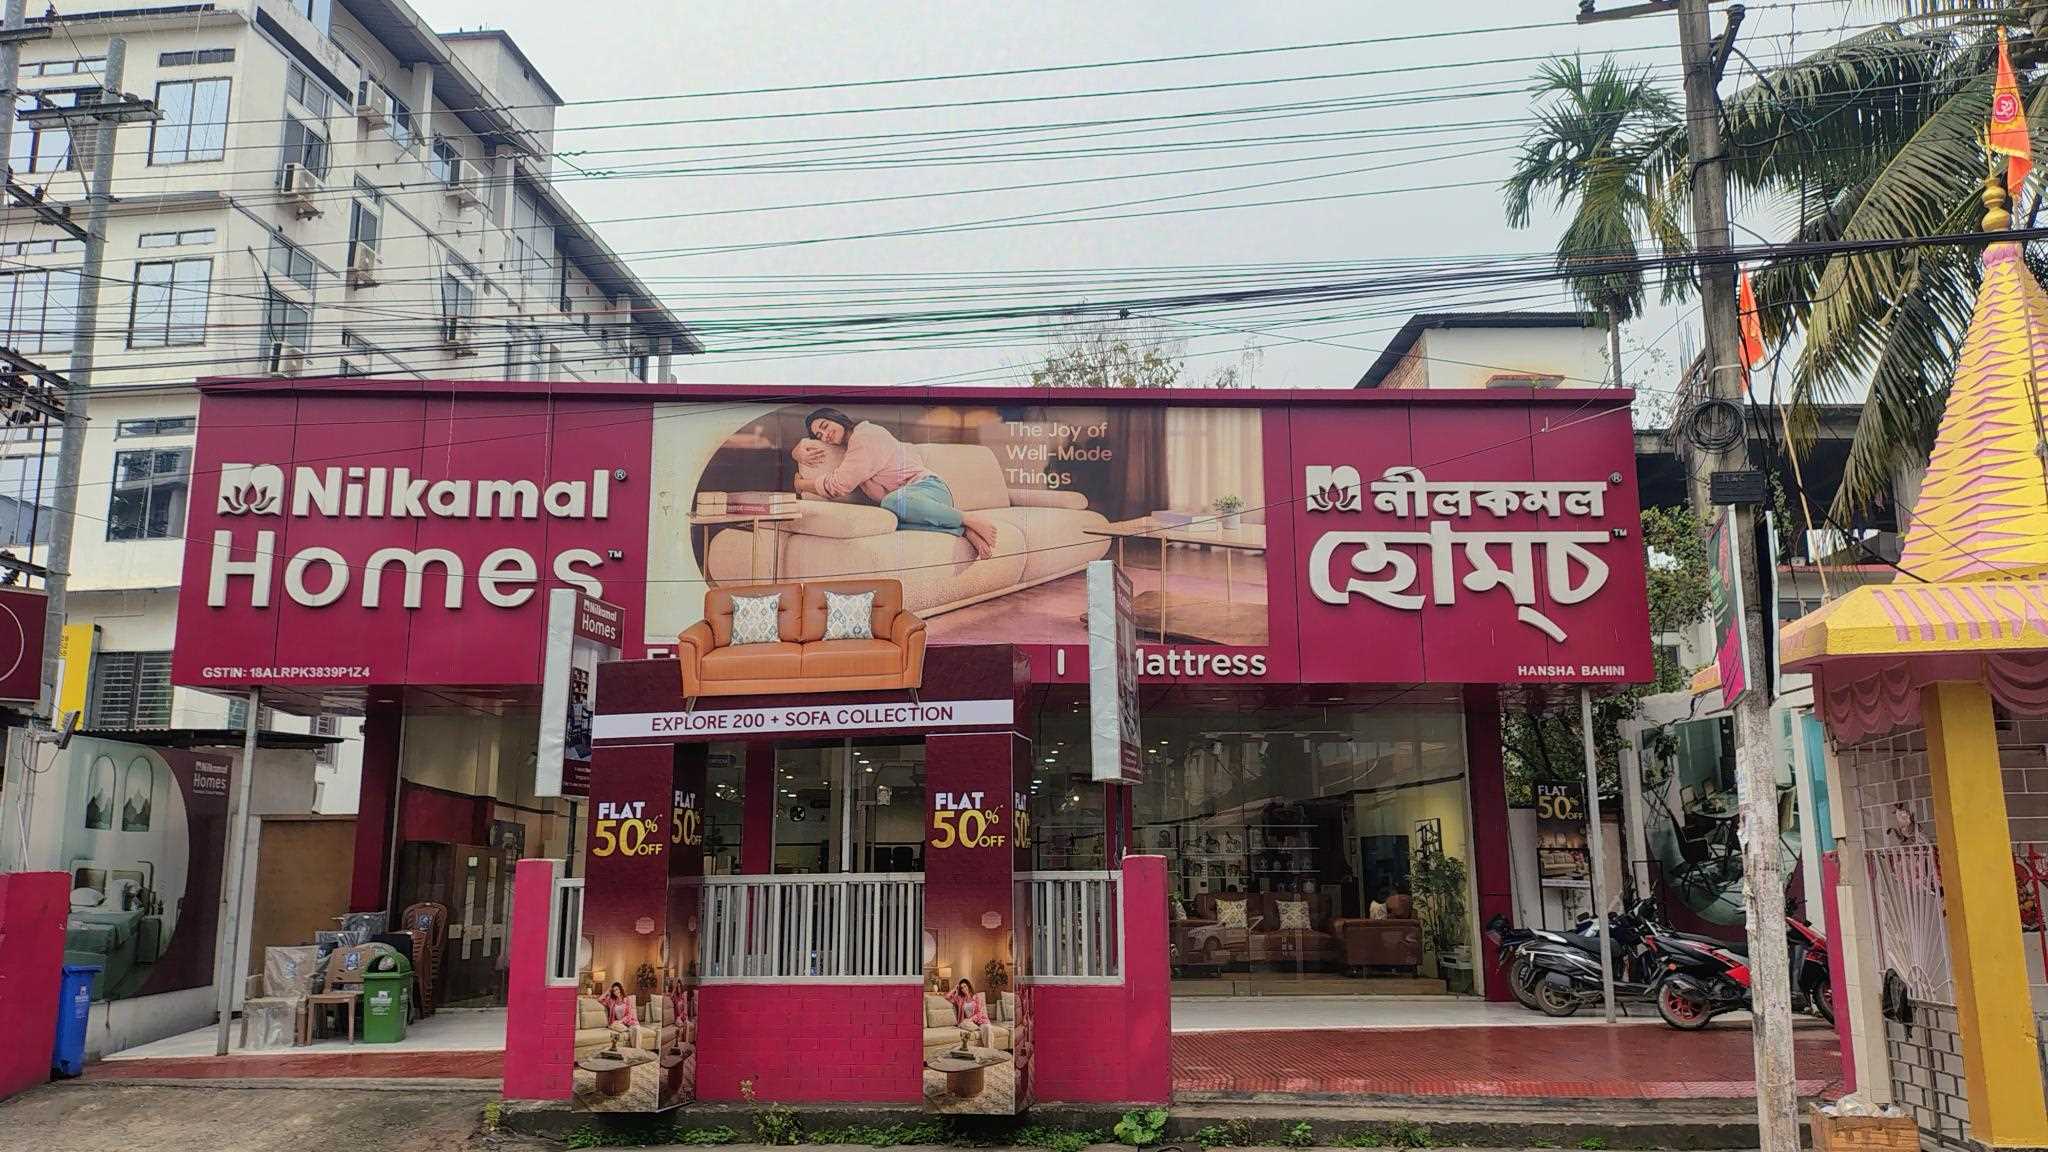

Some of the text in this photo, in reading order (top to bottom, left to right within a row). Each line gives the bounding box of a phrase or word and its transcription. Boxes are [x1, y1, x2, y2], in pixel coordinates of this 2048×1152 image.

[1005, 421, 1108, 442] The Joy of
[1006, 444, 1113, 461] Well-Made
[1005, 468, 1072, 489] Things
[292, 466, 609, 518] Nilkamal
[1371, 465, 1607, 517] নীলকমল
[207, 530, 605, 608] Homes
[582, 613, 616, 640] Homes
[1135, 649, 1267, 676] attress
[1518, 665, 1625, 677] HANSHA BAHINI
[202, 666, 371, 679] GSTIN: 18ALRPK3839P1Z4
[652, 715, 727, 731] EXPLORE
[733, 713, 765, 728] 200
[785, 710, 831, 726] SOFA
[837, 706, 953, 724] COLLECTION
[193, 773, 226, 789] Homes
[1538, 785, 1568, 796] FLAT
[674, 790, 696, 809] FLAT
[935, 792, 985, 810] FLAT
[598, 801, 646, 820] FLAT
[638, 844, 663, 855] OFF
[980, 836, 1006, 847] OFF
